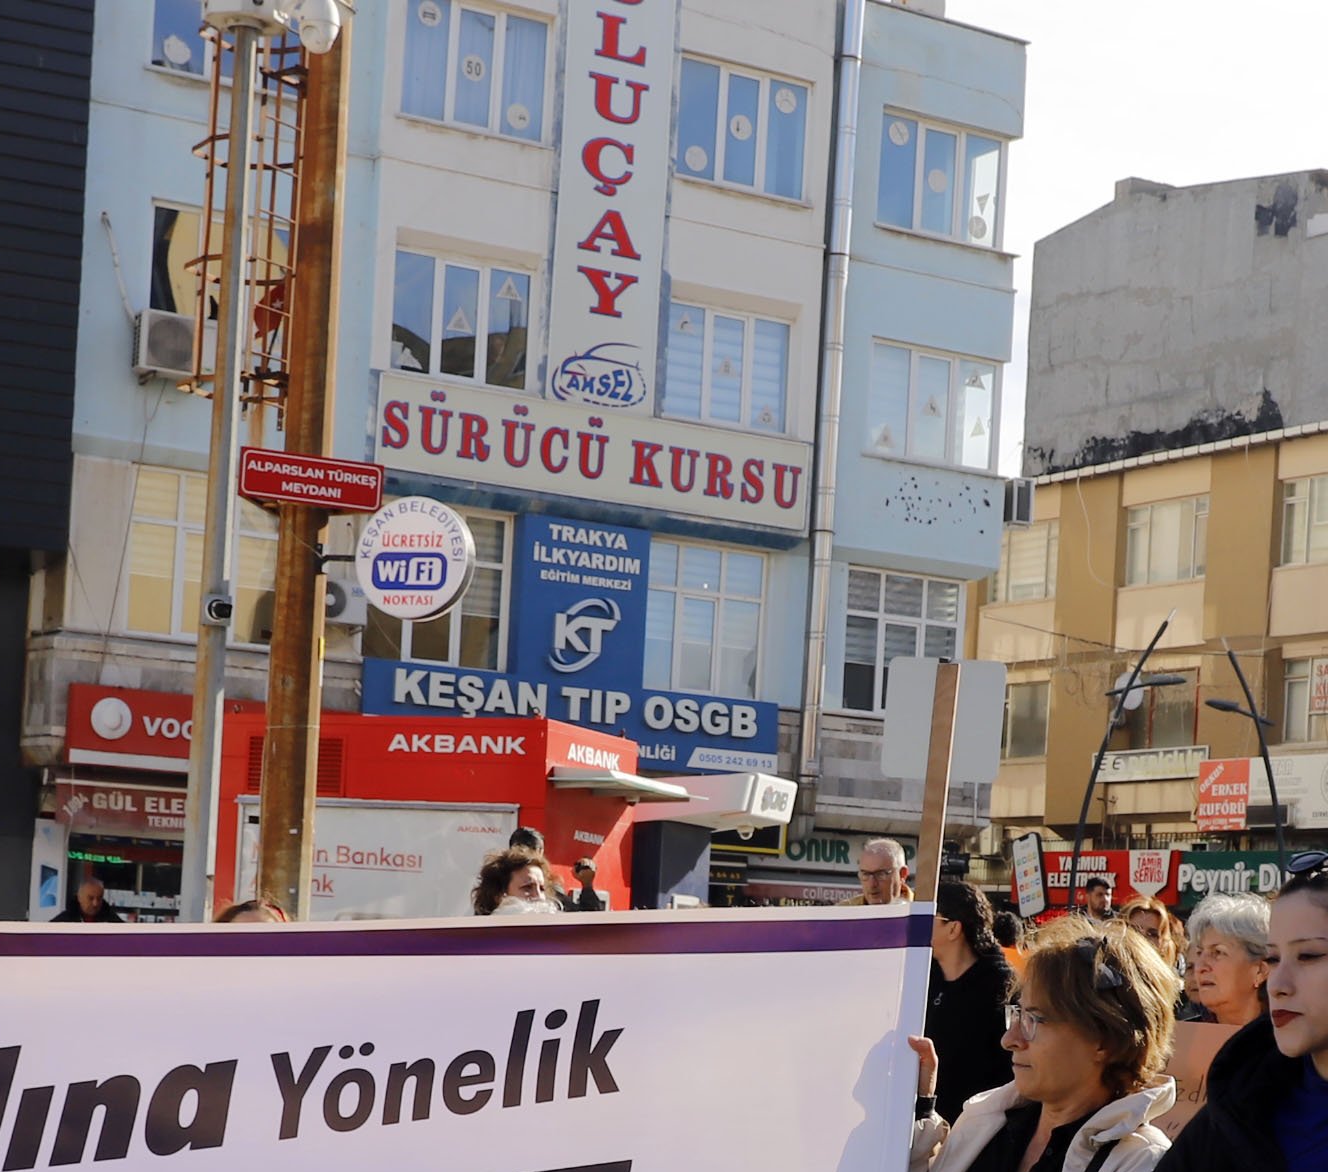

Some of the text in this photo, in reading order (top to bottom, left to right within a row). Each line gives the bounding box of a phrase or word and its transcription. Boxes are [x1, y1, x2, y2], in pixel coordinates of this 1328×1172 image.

[465, 59, 483, 78] 50
[577, 0, 650, 319] LUÇAY
[381, 391, 804, 511] SÜRÜCÜ KURSU
[247, 459, 378, 490] ALPARSLAN TÜRKEŞ
[281, 481, 342, 499] MEYDANI
[360, 500, 464, 563] KEŞAN BELEDİYESİ
[381, 531, 444, 548] ÜCRETSİZ
[548, 522, 629, 551] TRAKYA
[376, 558, 436, 583] WiFi
[532, 541, 641, 576] İLKYARDIM
[539, 567, 633, 592] EĞİTİM MERKEZİ
[383, 594, 433, 606] NOKTASI
[392, 666, 759, 739] KEŞAN TIP OSGB
[387, 732, 621, 771] AKBANK AKBANK
[698, 753, 724, 764] 0505
[725, 755, 744, 766] 242
[746, 757, 760, 768] 69
[92, 791, 139, 813] GÜL
[1211, 782, 1249, 797] ERKEK
[456, 825, 605, 845] AKBANK AKBANK
[336, 844, 423, 868] Bankası
[785, 838, 851, 864] ONUR
[1136, 857, 1163, 870] TAMİR
[1177, 861, 1257, 894] Peynir
[270, 998, 626, 1142] Yönelik
